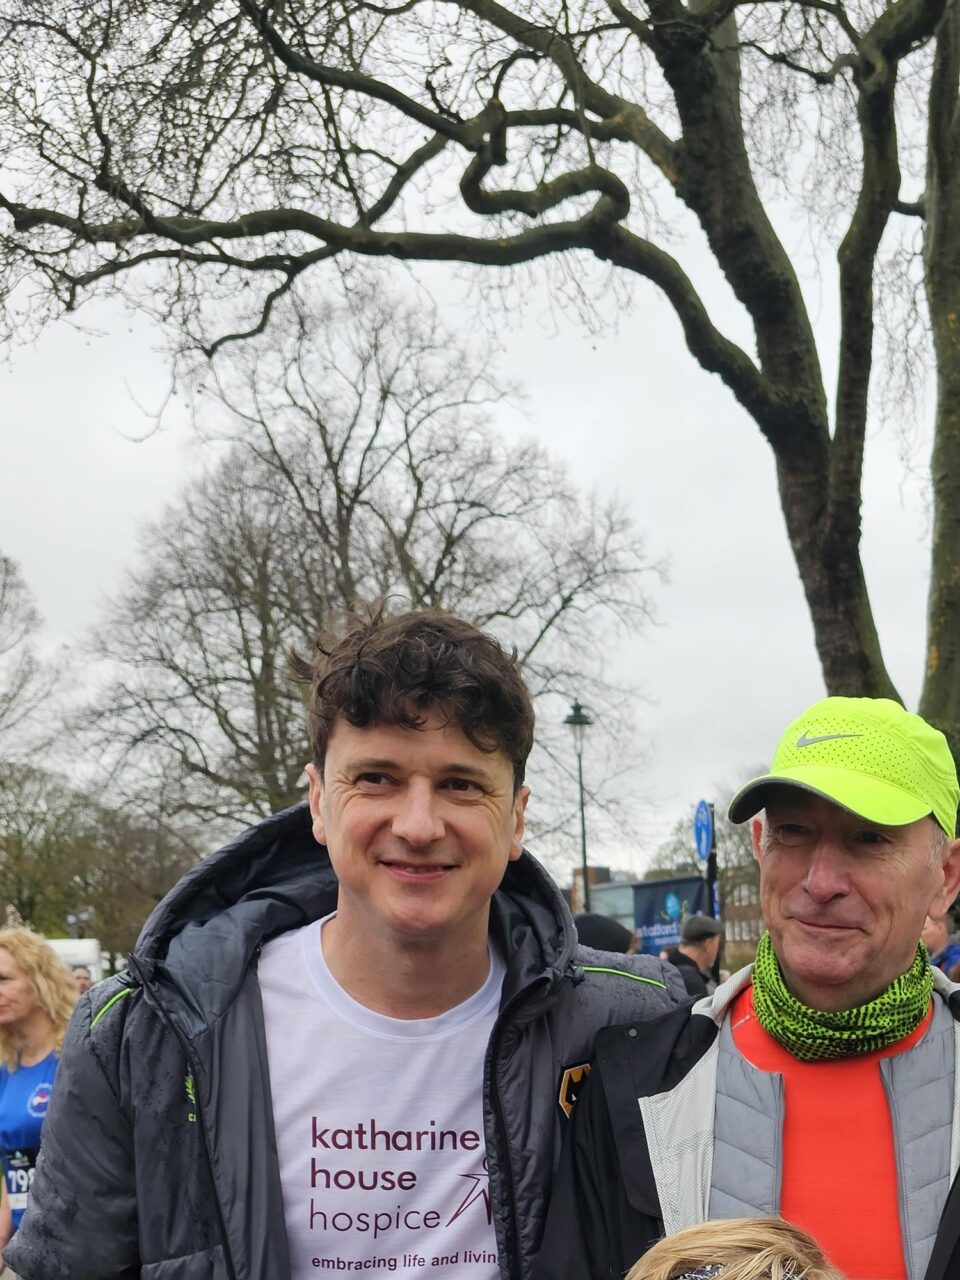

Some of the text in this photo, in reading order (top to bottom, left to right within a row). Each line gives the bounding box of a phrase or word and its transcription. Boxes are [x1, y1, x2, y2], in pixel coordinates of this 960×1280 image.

[312, 1116, 480, 1150] katharine
[311, 1157, 417, 1190] house
[310, 1198, 441, 1239] hospice
[312, 1250, 501, 1271] embracing life and livin
